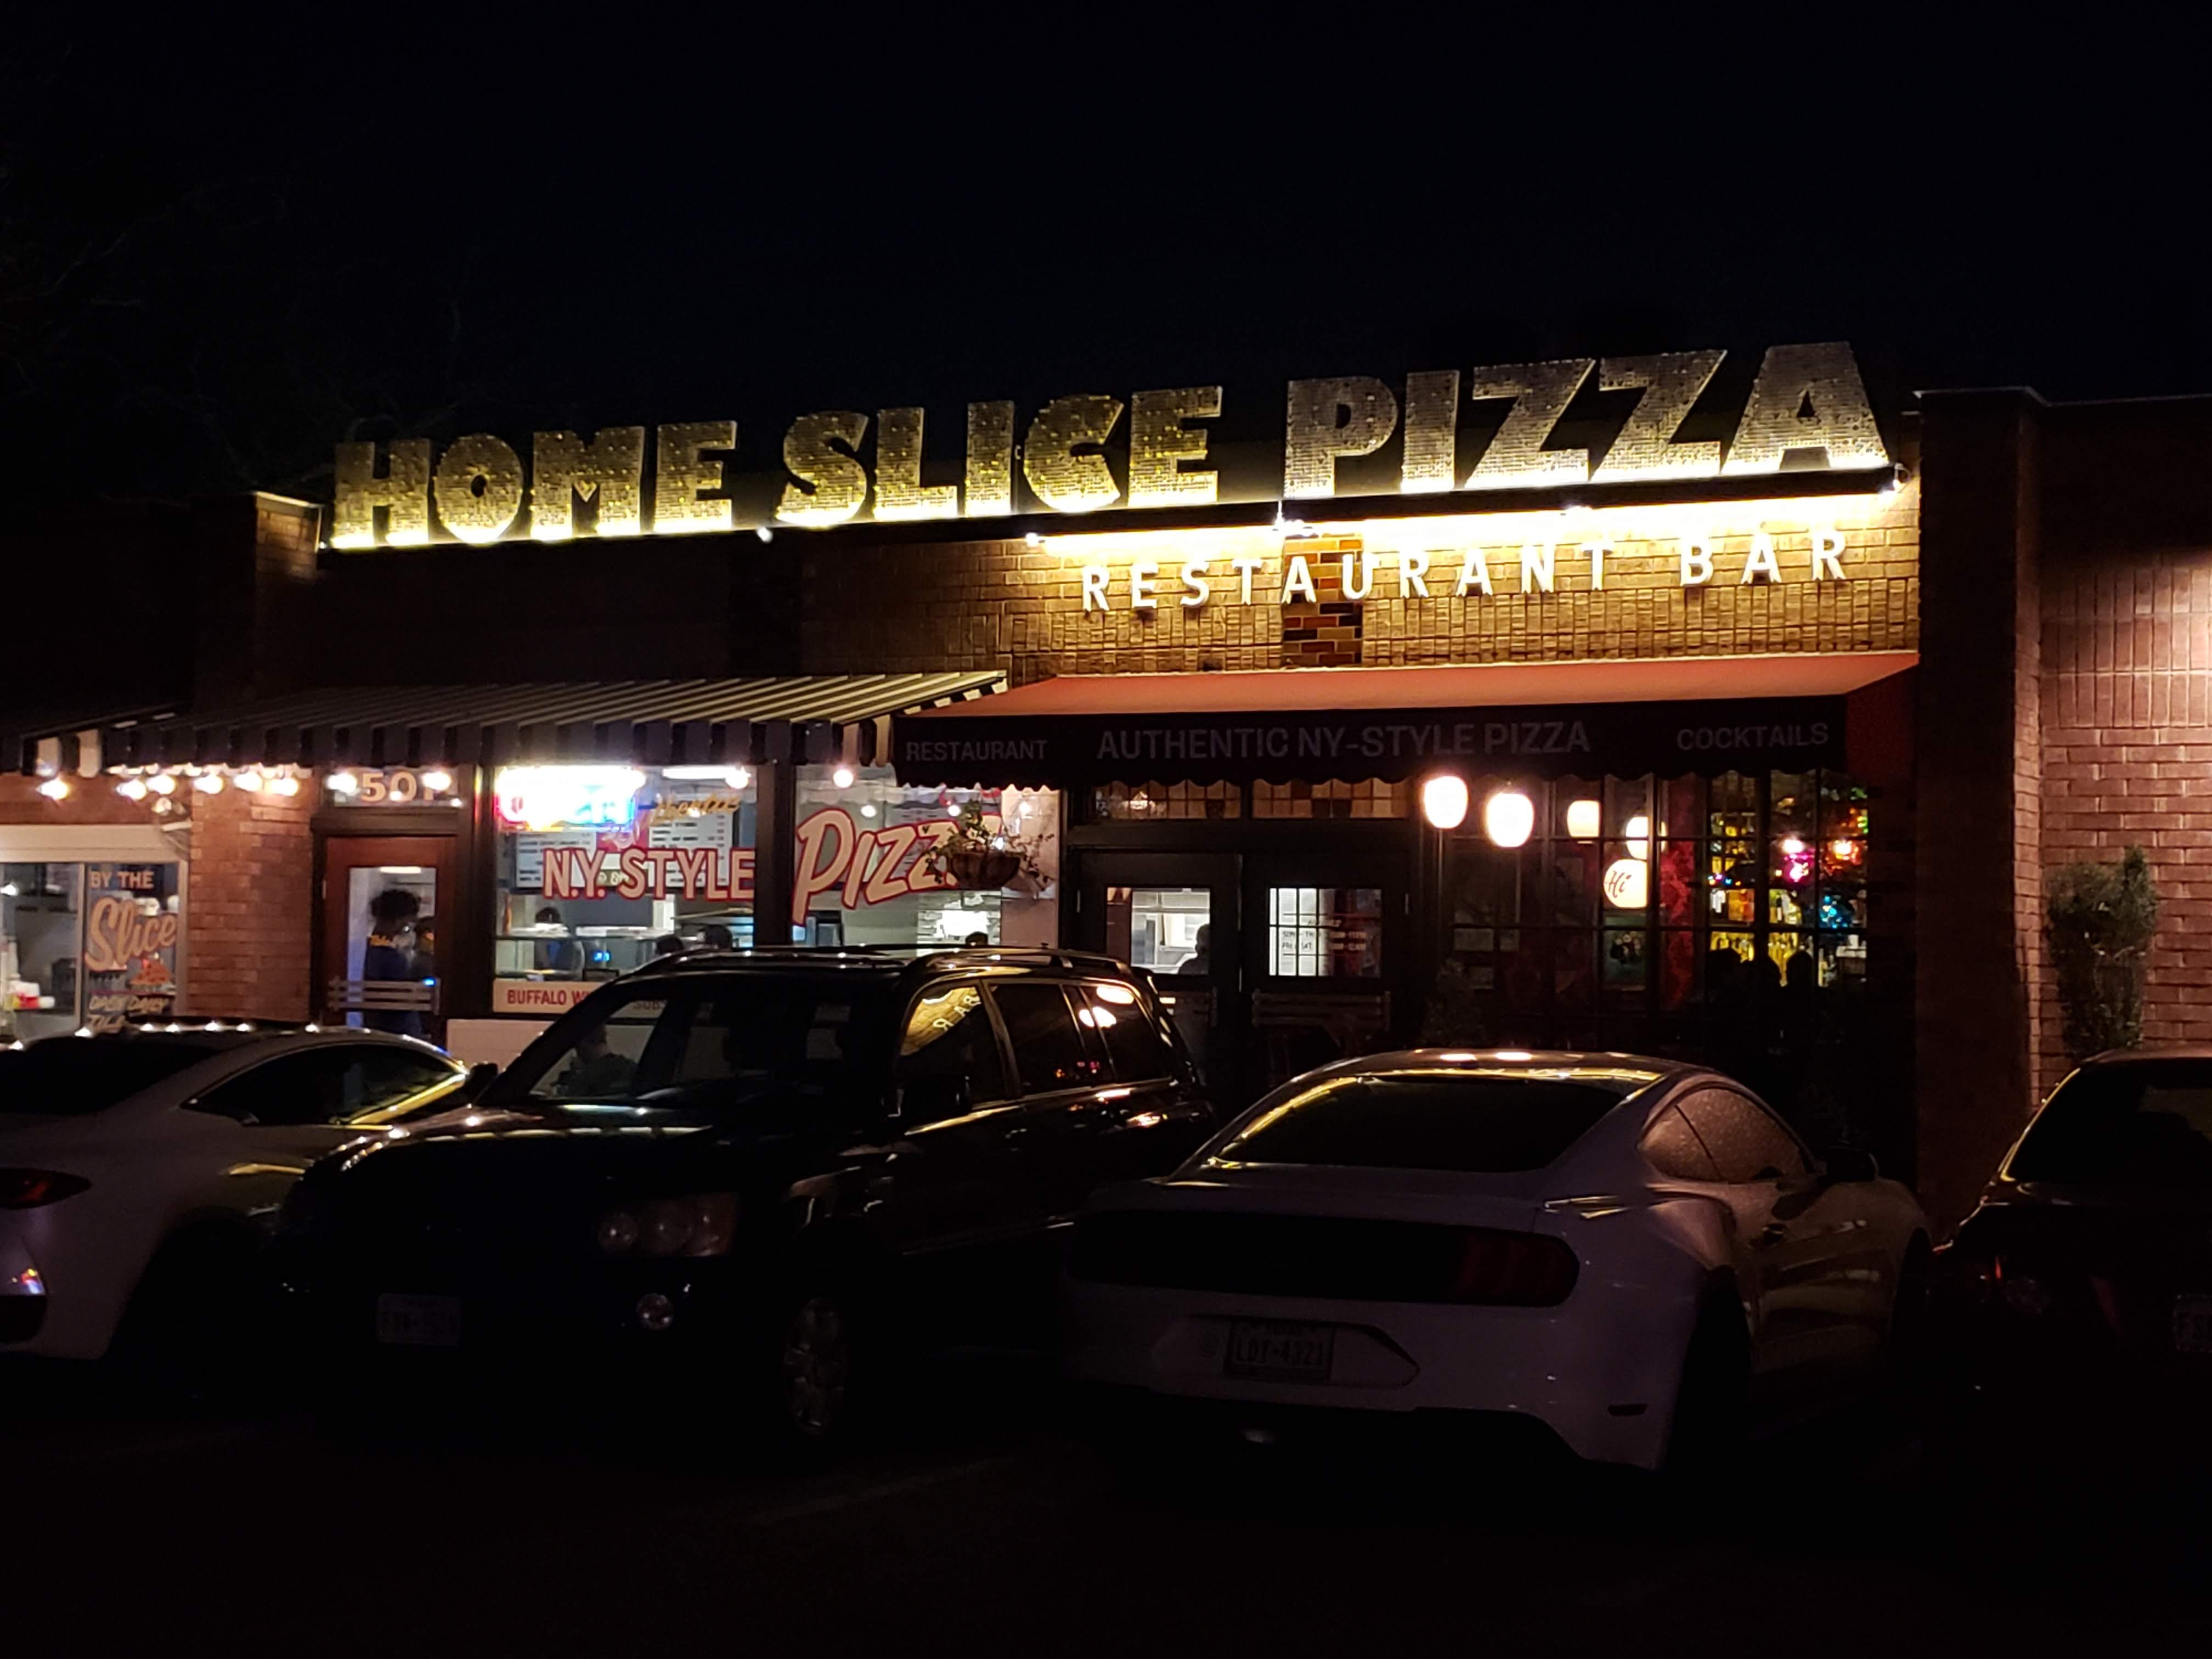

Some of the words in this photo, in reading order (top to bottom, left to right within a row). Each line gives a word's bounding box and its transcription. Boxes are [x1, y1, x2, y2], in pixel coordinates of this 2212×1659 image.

[330, 421, 737, 549] HOME
[776, 386, 1223, 527] SLICE
[1283, 341, 1890, 498] PIZZA
[1081, 540, 1612, 612] RESTAURANT
[1679, 528, 1847, 586] BAR
[905, 738, 1048, 762] RESTAURANT
[1097, 726, 1289, 760] AUTHENTIC
[1298, 722, 1475, 758] NY-STYLE
[1485, 719, 1592, 754] PIZZA
[1675, 723, 1830, 752] COCKTAILS
[89, 871, 112, 888] BY
[117, 871, 155, 889] THE
[617, 847, 755, 901] STYLE
[84, 896, 176, 972] Slice
[507, 989, 567, 1005] BUFFALO
